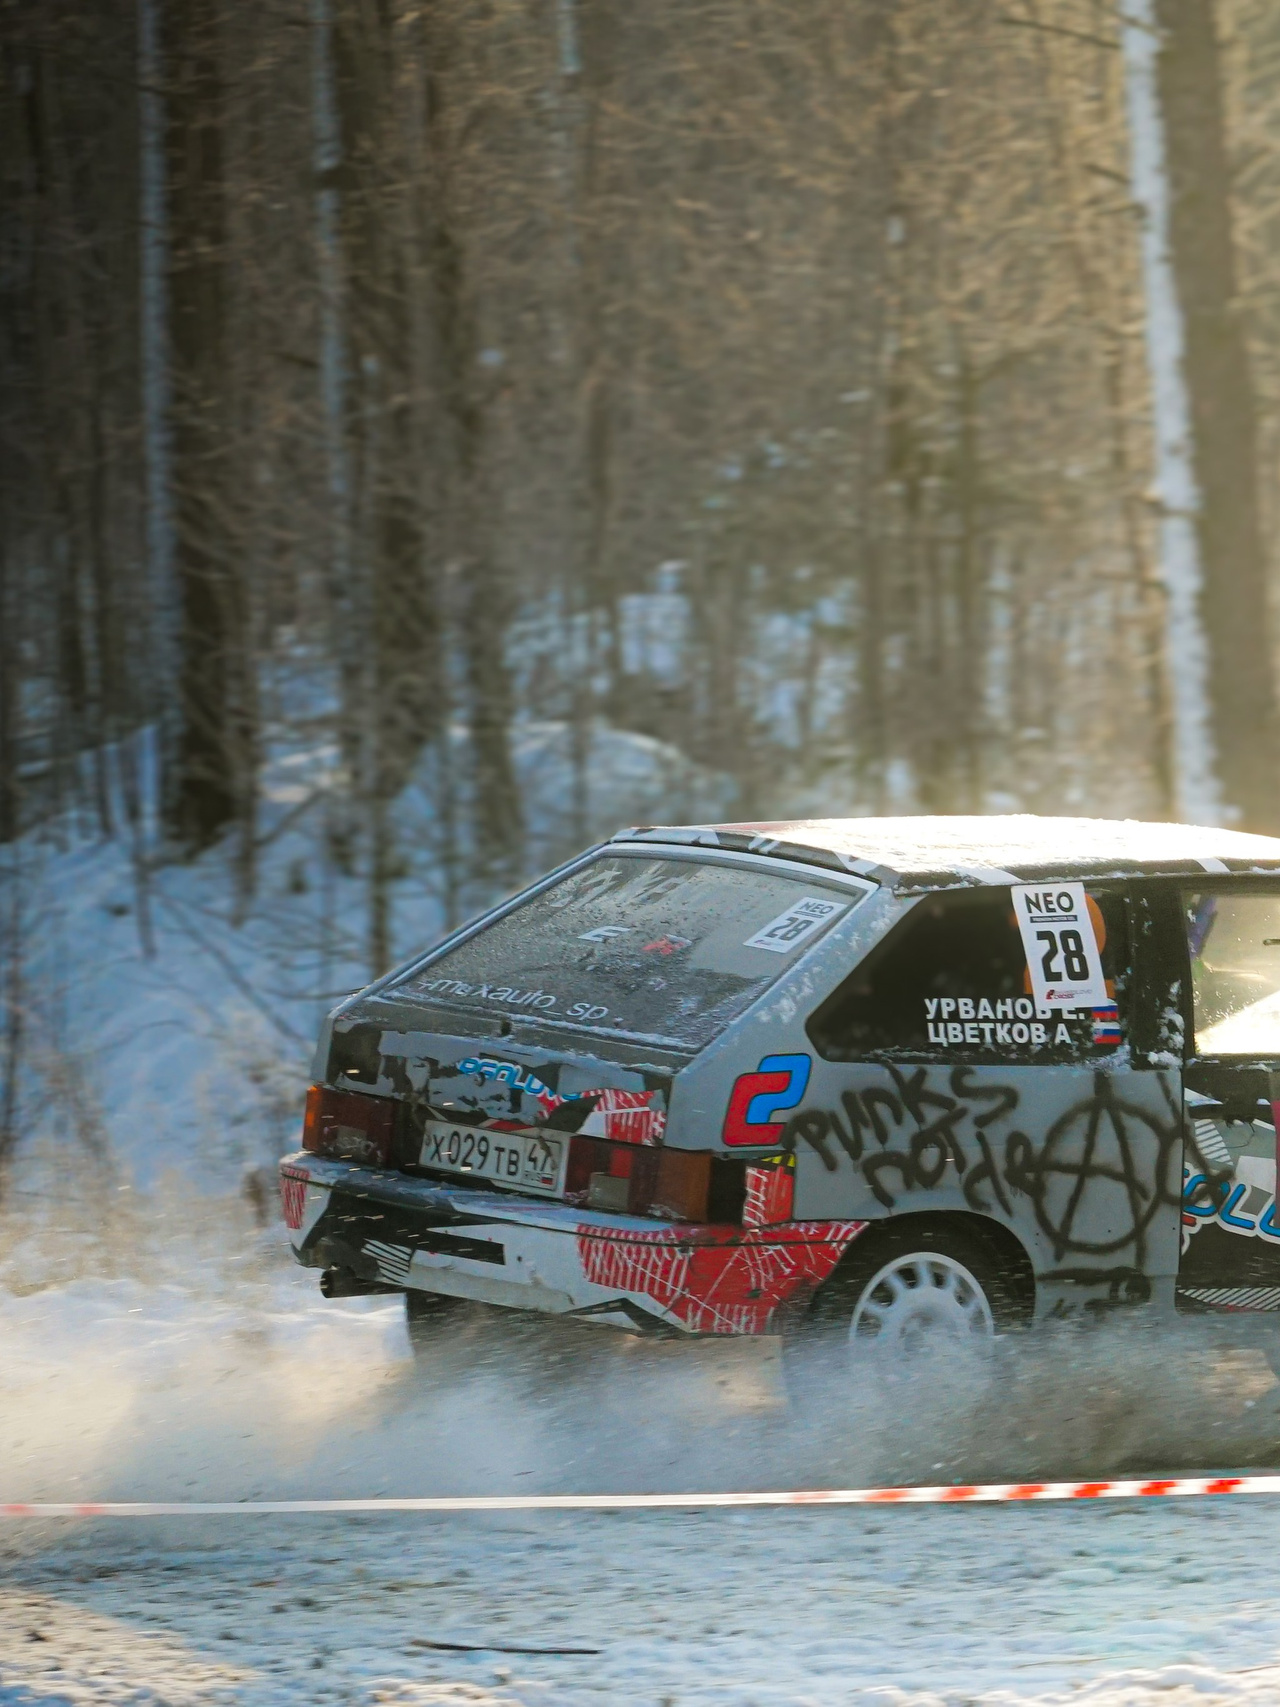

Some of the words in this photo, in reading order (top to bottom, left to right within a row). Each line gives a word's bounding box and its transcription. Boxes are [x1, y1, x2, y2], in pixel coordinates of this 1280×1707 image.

[800, 901, 834, 915] NEO
[1024, 891, 1074, 914] NEO
[764, 916, 815, 941] 28
[1036, 929, 1090, 983] 28
[927, 1022, 1047, 1047] ЦВЕТКОВ
[1054, 1023, 1072, 1044] А
